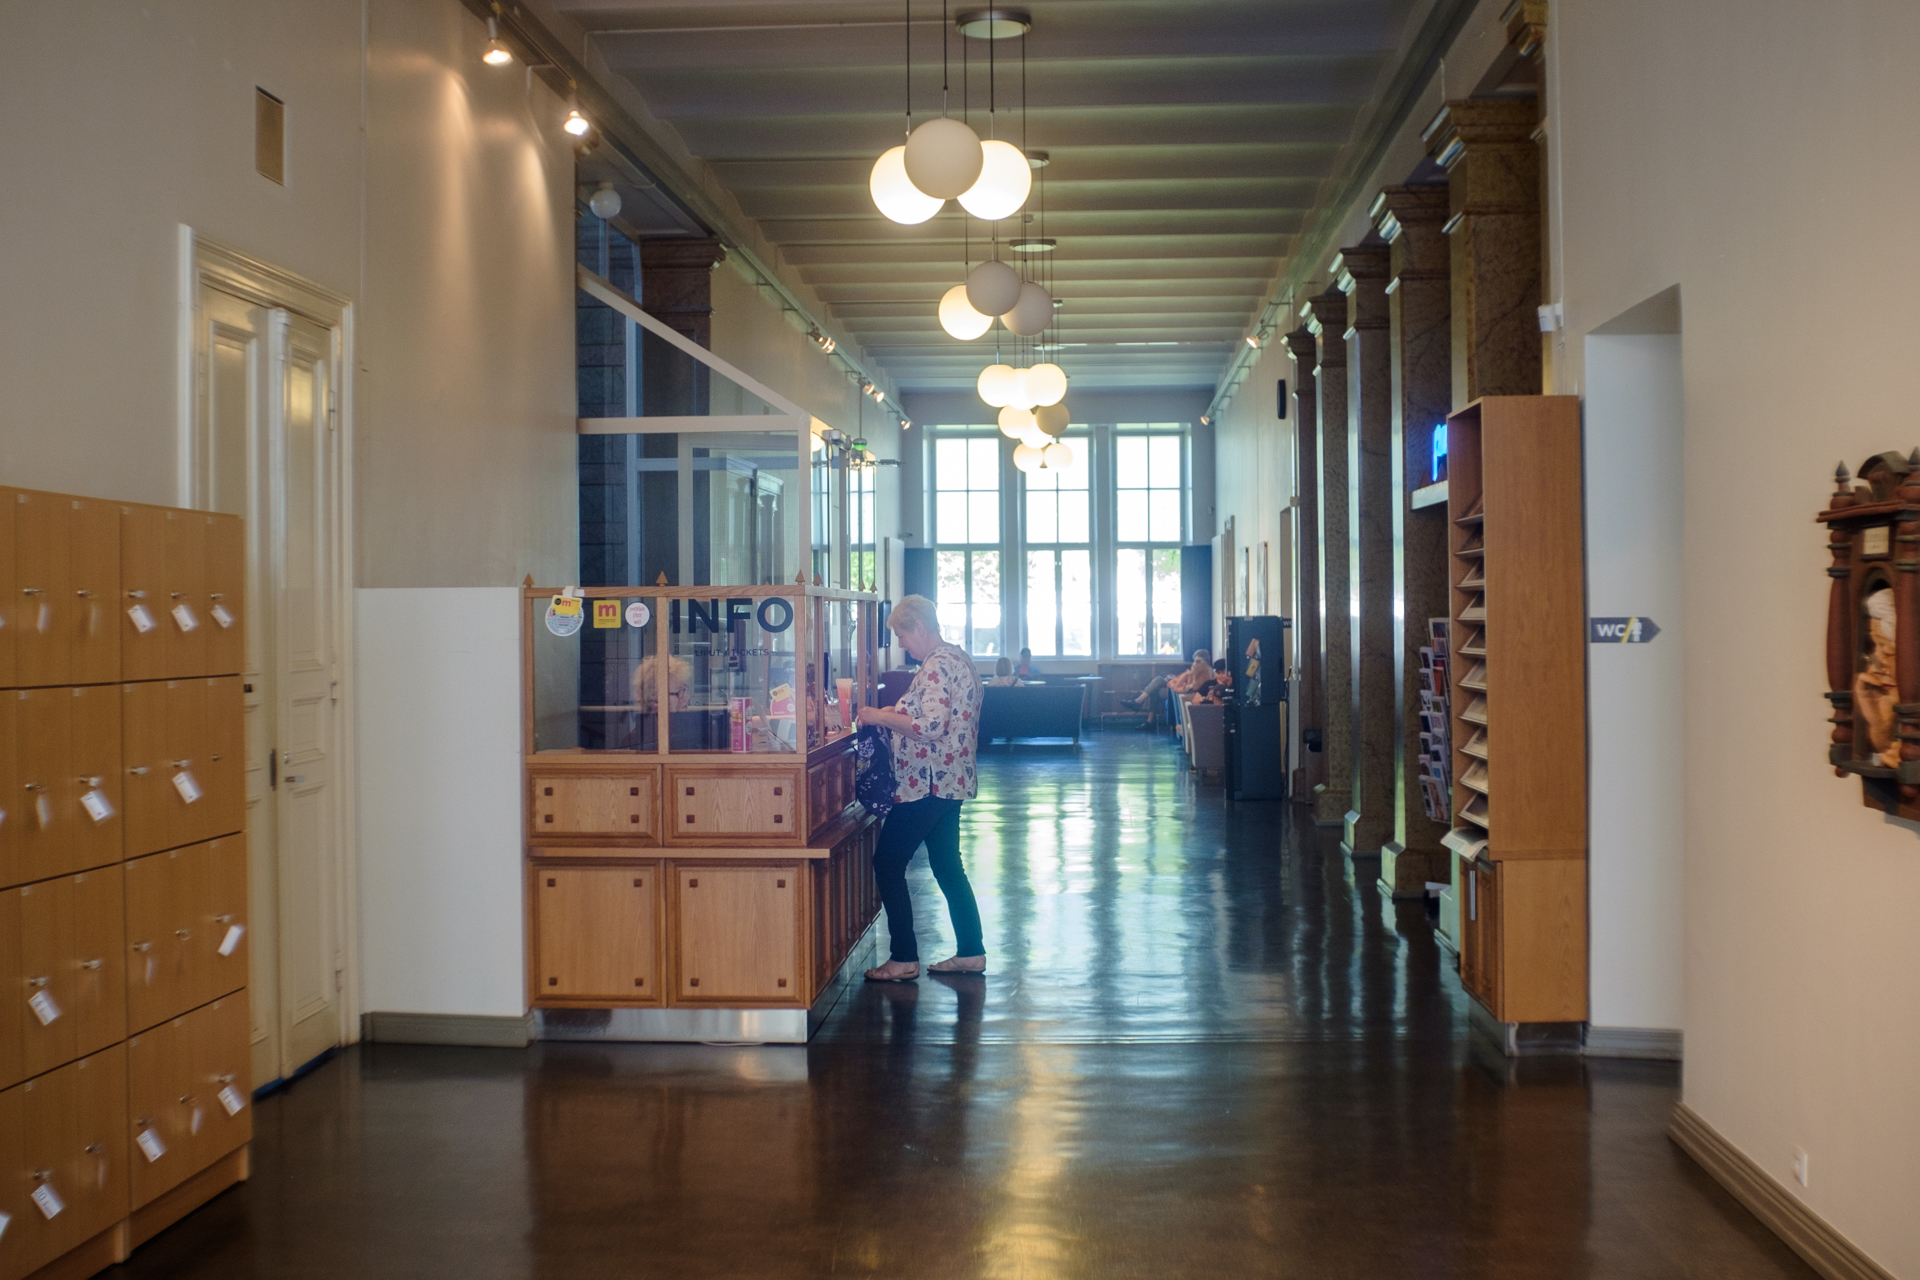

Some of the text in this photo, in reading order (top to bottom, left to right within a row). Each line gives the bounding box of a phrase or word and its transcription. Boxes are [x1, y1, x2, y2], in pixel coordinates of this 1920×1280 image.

[598, 604, 617, 618] m
[672, 596, 794, 634] INFO
[1596, 623, 1627, 637] WC
[695, 649, 722, 657] LIPUT
[731, 648, 770, 657] TICKETS
